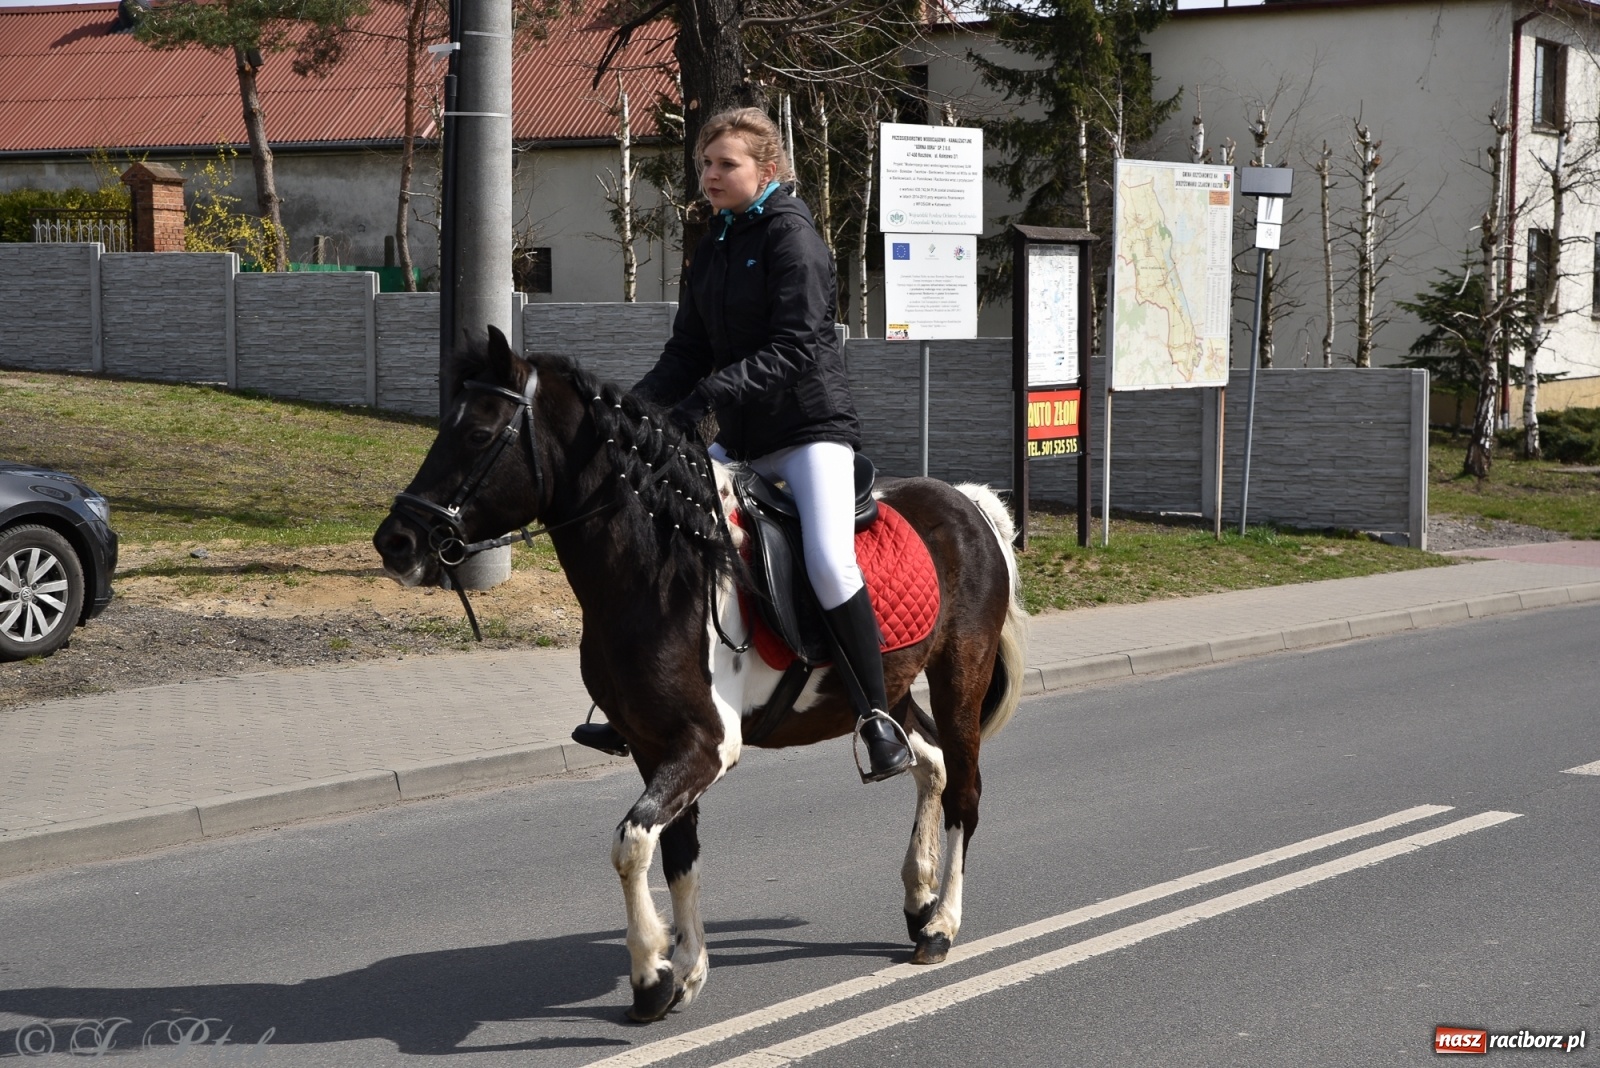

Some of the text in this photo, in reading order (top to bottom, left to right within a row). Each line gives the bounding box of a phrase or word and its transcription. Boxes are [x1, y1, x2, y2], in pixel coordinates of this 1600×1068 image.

[1028, 400, 1078, 427] AUTO ZŁOM
[1028, 438, 1077, 456] TEL. 501 525 515
